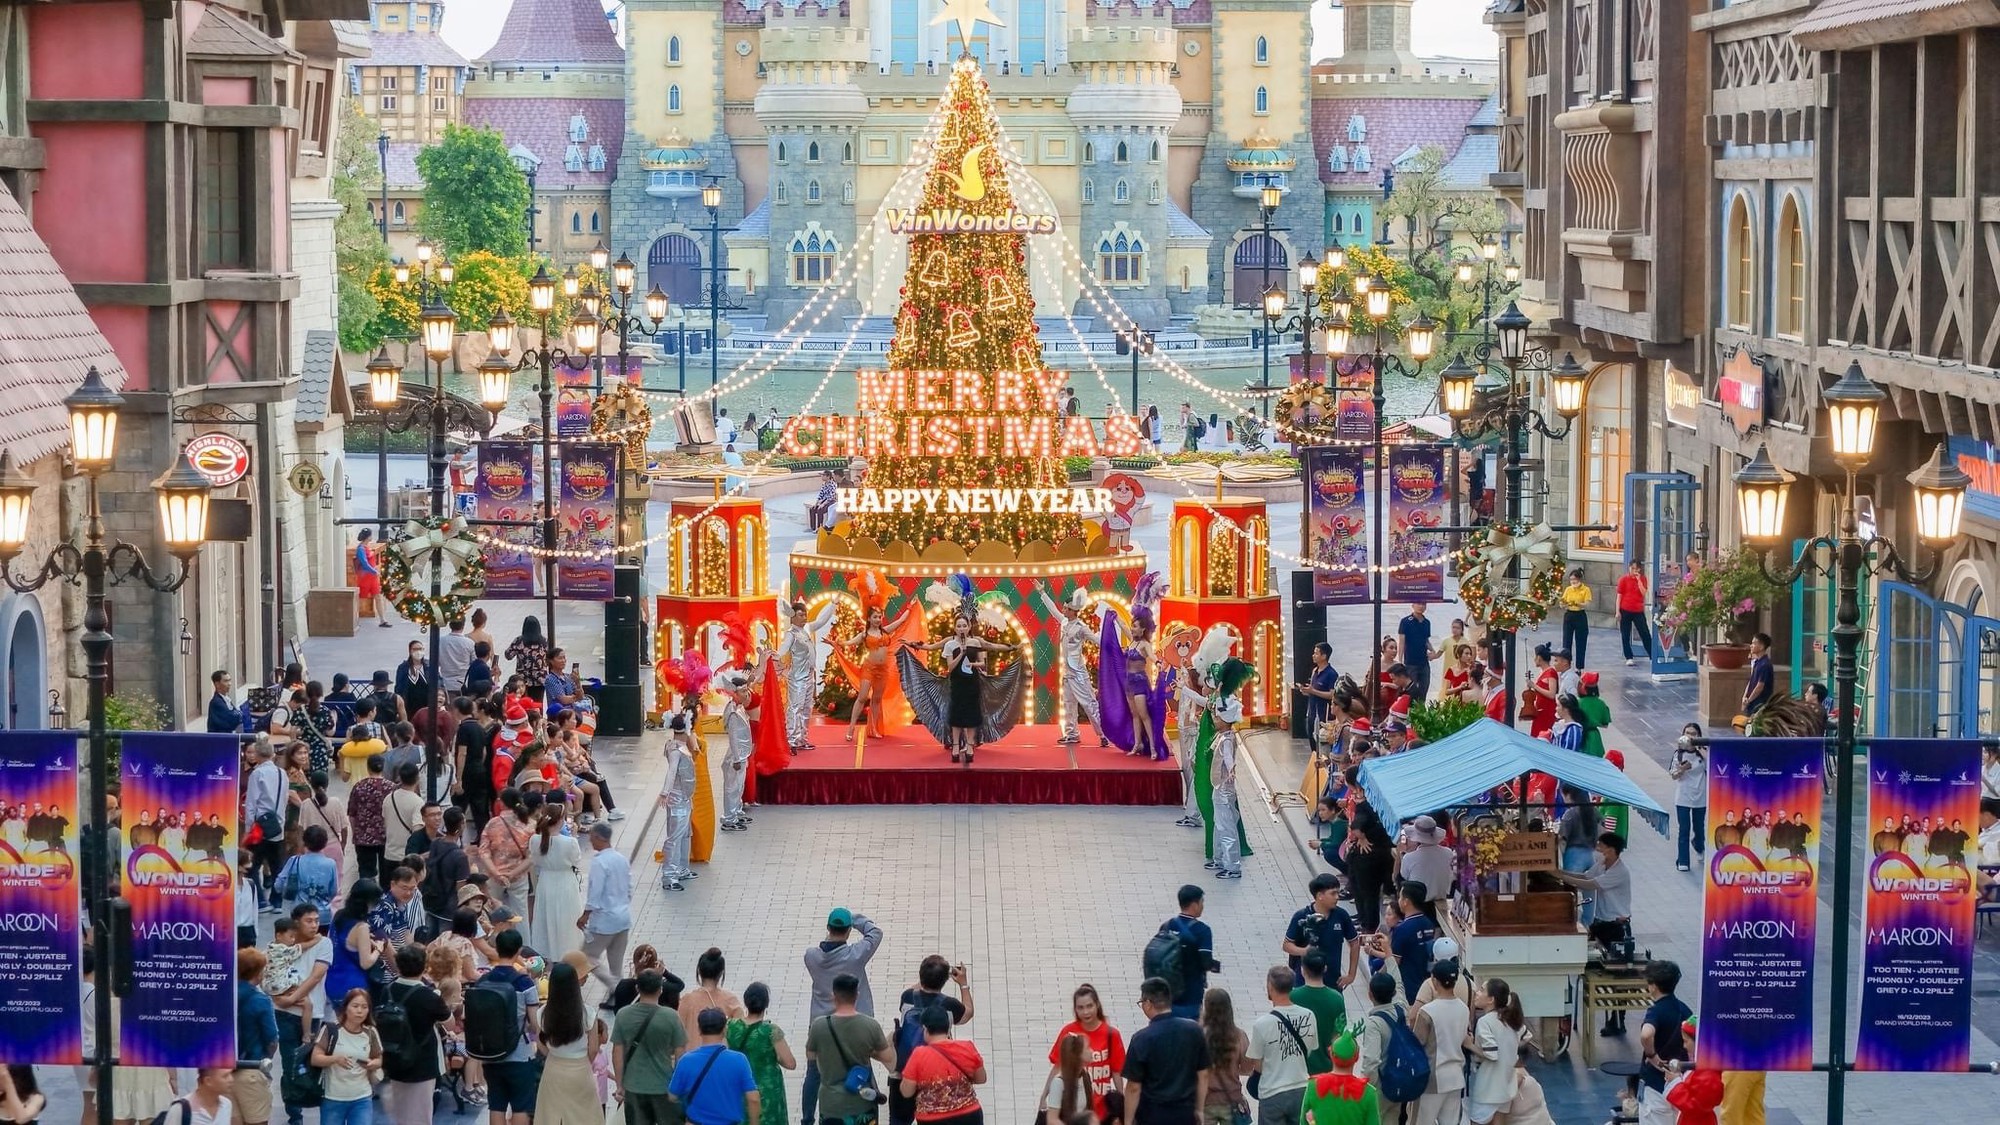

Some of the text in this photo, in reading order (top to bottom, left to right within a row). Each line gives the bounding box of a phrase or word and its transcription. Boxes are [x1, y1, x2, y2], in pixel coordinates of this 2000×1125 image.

[887, 208, 1056, 234] VinWonders
[857, 367, 1069, 412] MERRY
[783, 415, 1142, 457] CHRISTMAS
[188, 437, 245, 458] HIGHLANDS
[836, 488, 1115, 513] HAPPY NEW YEAR
[0, 864, 72, 880] ONDER
[1714, 871, 1810, 887] WONDER
[132, 872, 230, 889] WONDER
[1872, 877, 1969, 894] WONDER
[160, 887, 199, 895] WINTER
[1742, 886, 1781, 894] WINTER
[1901, 893, 1939, 901] WINTER
[0, 913, 58, 931] ROON
[1709, 920, 1795, 939] MAROON
[1867, 926, 1954, 946] MAROON
[134, 960, 153, 968] TOC
[179, 962, 223, 970] JUSTATEE
[1893, 966, 1912, 974] TIEN
[182, 973, 228, 981] DOUBLE2T
[1867, 976, 1903, 984] PHUONG
[1919, 977, 1965, 985] DOUBLE2T
[188, 983, 218, 991] 2PILLZ
[1876, 986, 1900, 994] GREY
